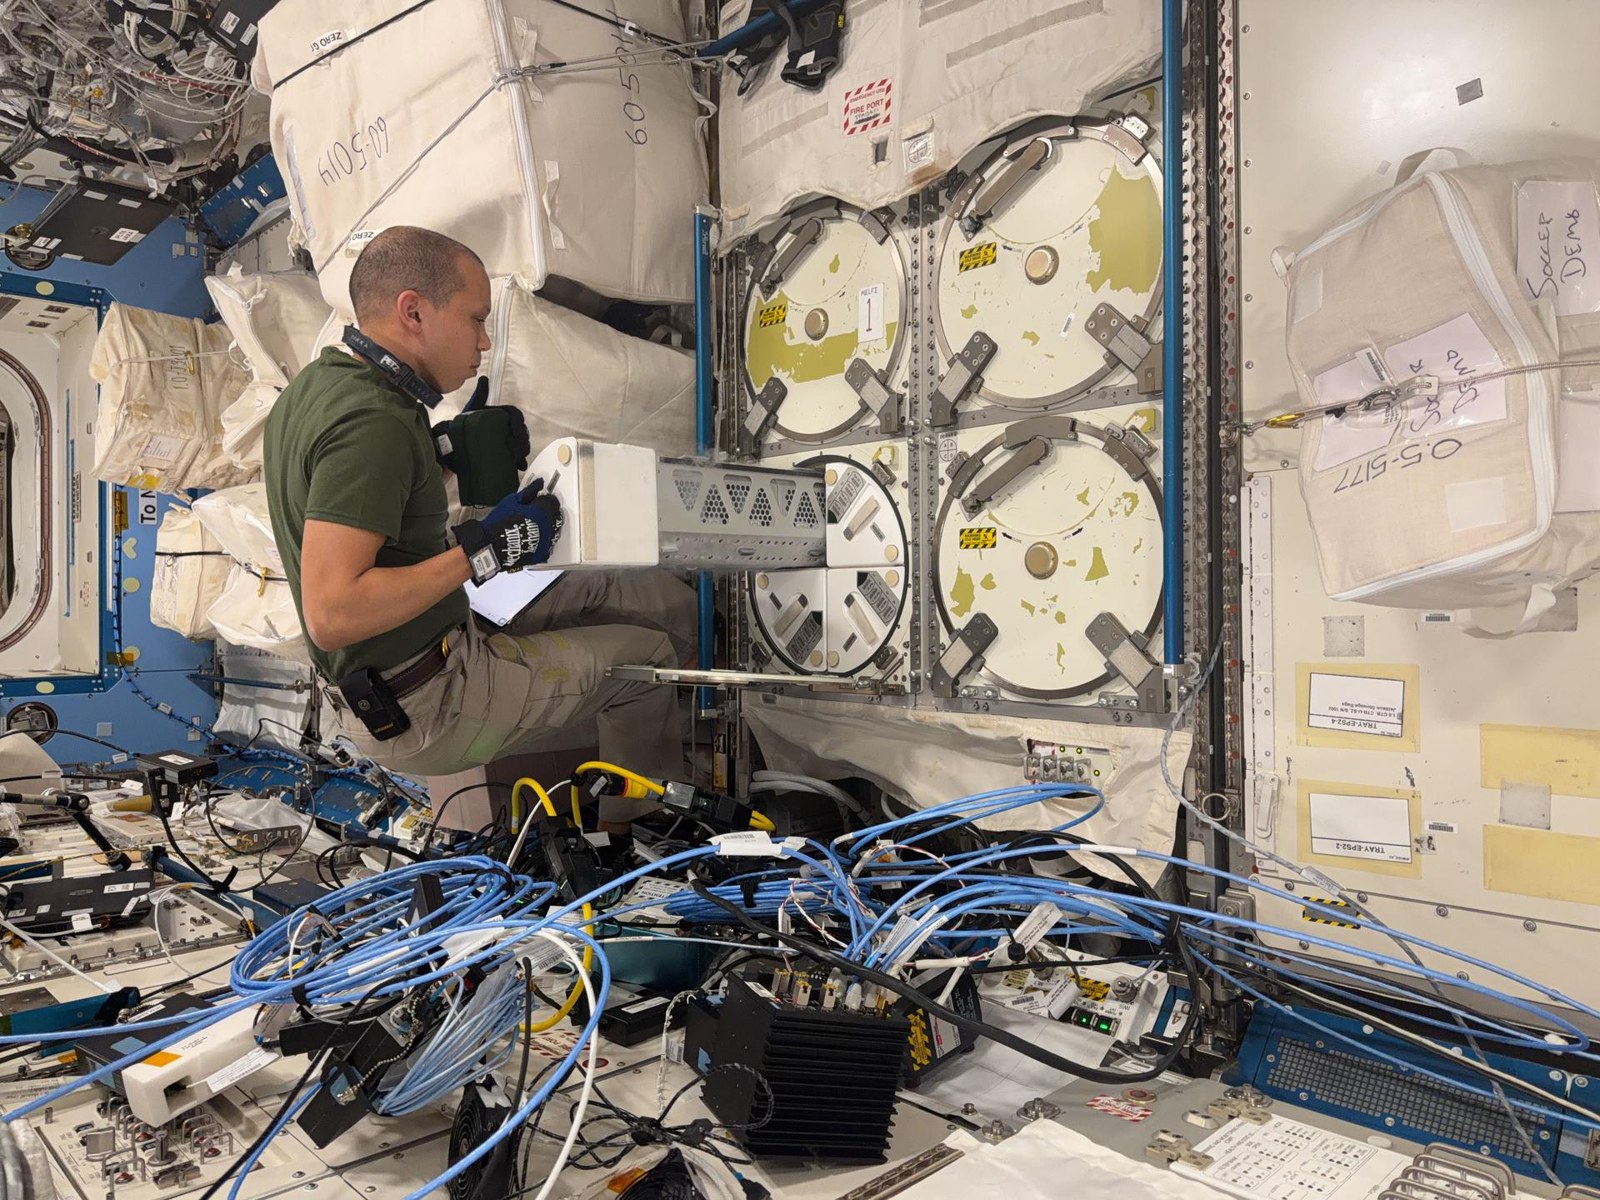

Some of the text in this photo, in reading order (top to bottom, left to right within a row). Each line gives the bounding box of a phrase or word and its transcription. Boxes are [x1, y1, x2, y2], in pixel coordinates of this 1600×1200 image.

[319, 31, 343, 47] ZERO
[849, 104, 864, 116] FIRE
[865, 97, 884, 110] PORT
[352, 231, 374, 241] ZERO
[860, 286, 879, 297] MELFI
[1333, 437, 1464, 494] 0.5-5177
[140, 503, 157, 524] To
[1330, 718, 1377, 729] TRAY-EPS2-4
[1335, 842, 1385, 853] TRAY-EPS2-2
